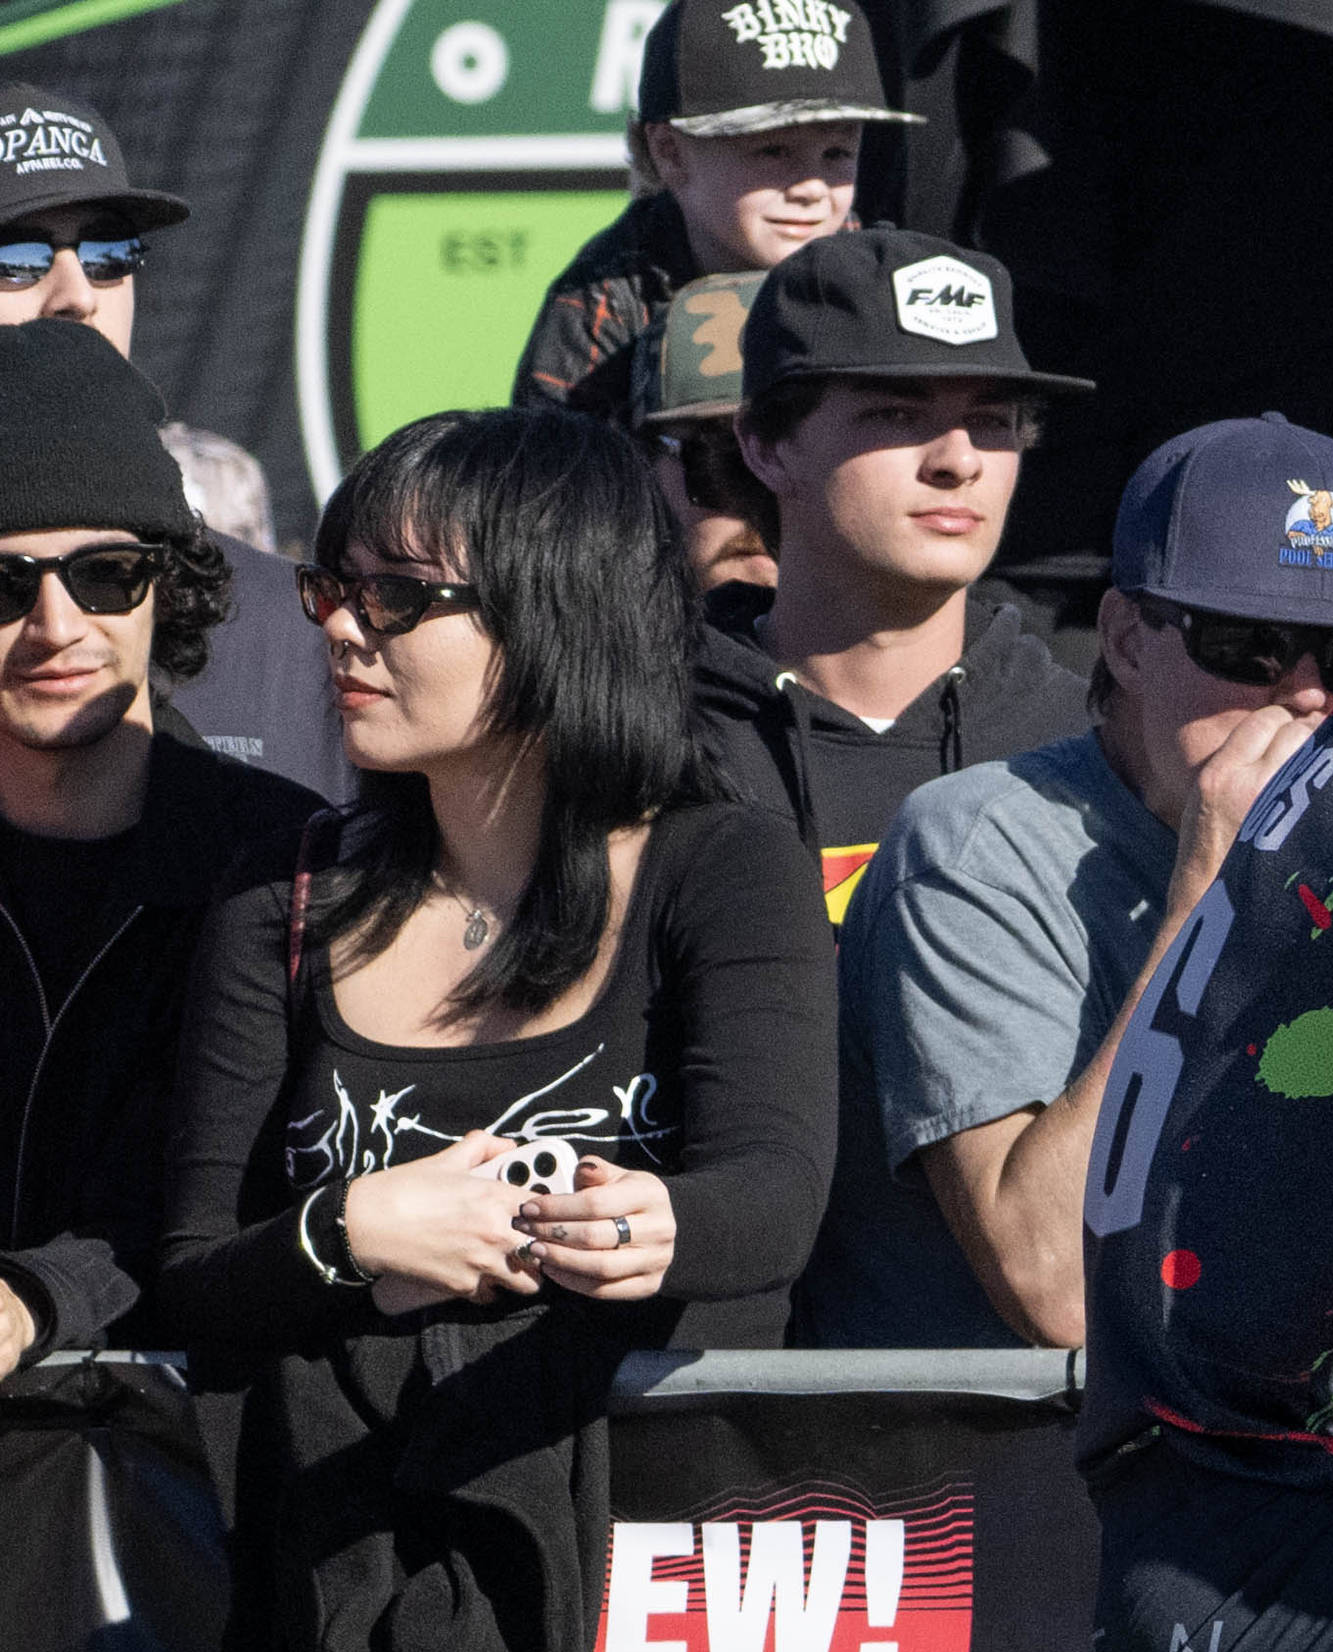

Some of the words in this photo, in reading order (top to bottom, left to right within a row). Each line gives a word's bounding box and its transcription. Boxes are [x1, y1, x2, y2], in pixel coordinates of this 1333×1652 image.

[758, 33, 840, 70] BRO
[441, 232, 528, 272] EST
[905, 283, 986, 308] FMF
